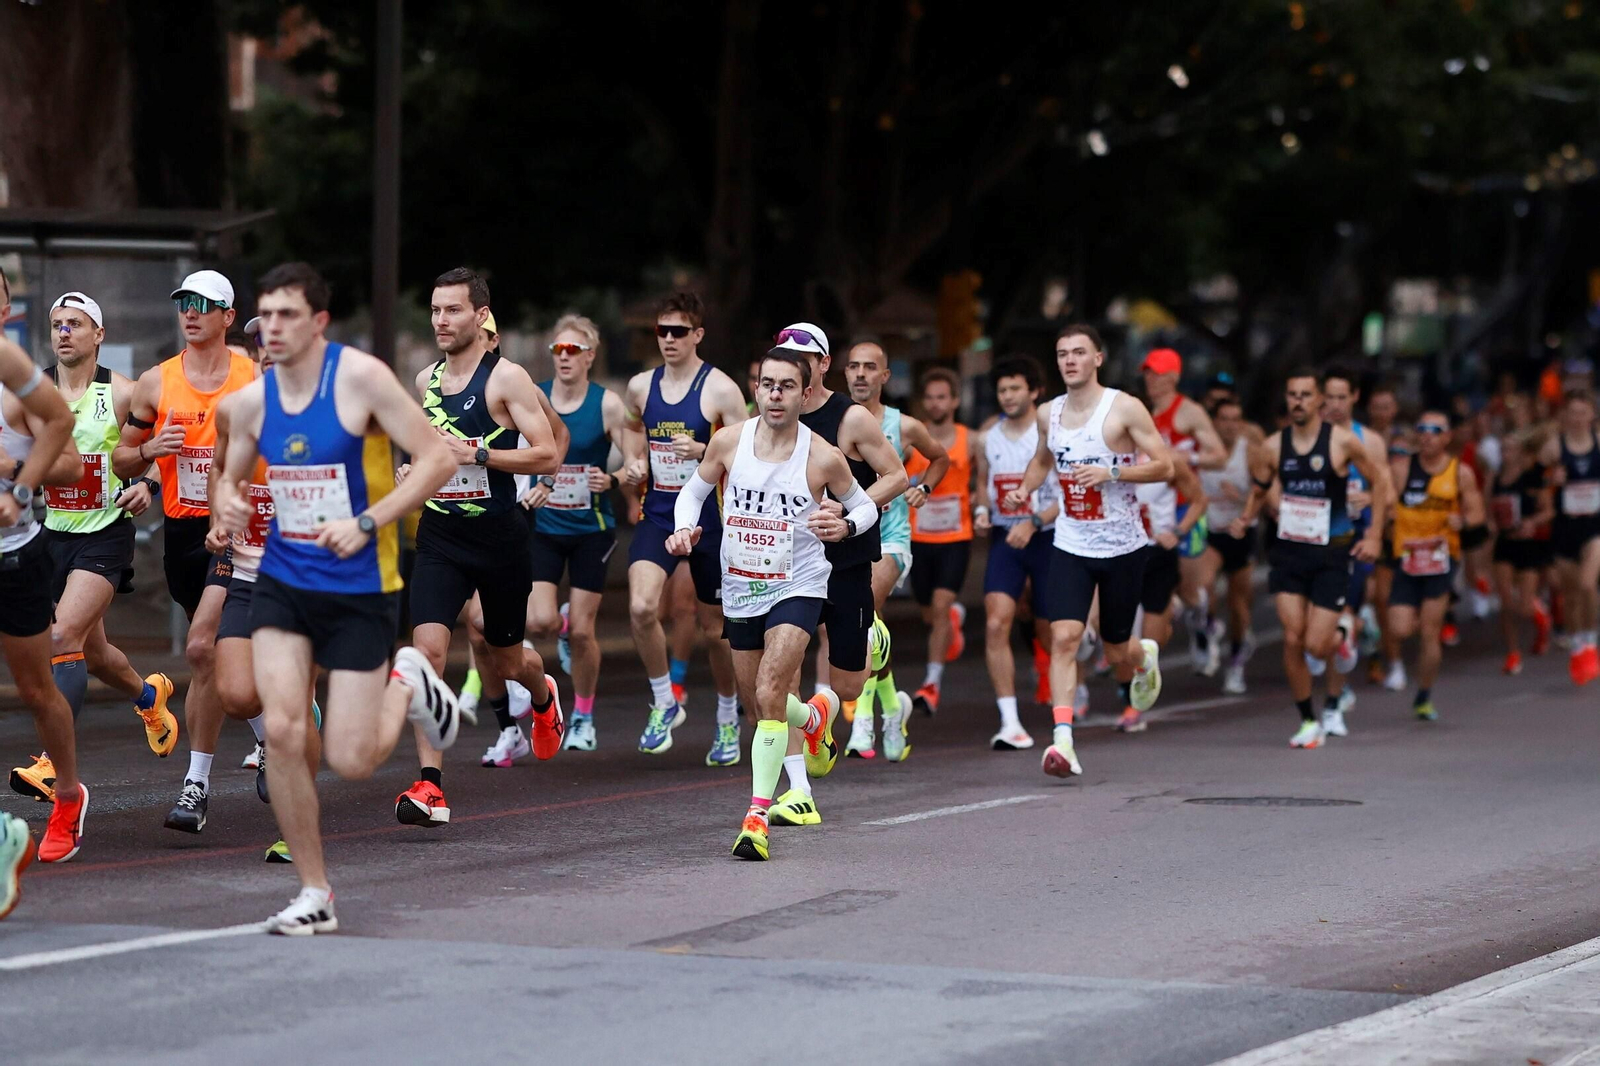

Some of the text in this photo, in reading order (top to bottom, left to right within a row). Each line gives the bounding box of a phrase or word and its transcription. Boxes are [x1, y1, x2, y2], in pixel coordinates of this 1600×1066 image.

[657, 421, 685, 429] LONDON
[282, 486, 325, 501] 14577
[733, 485, 808, 517] ATLAS
[741, 518, 783, 531] GENERALI
[737, 531, 775, 547] 14552
